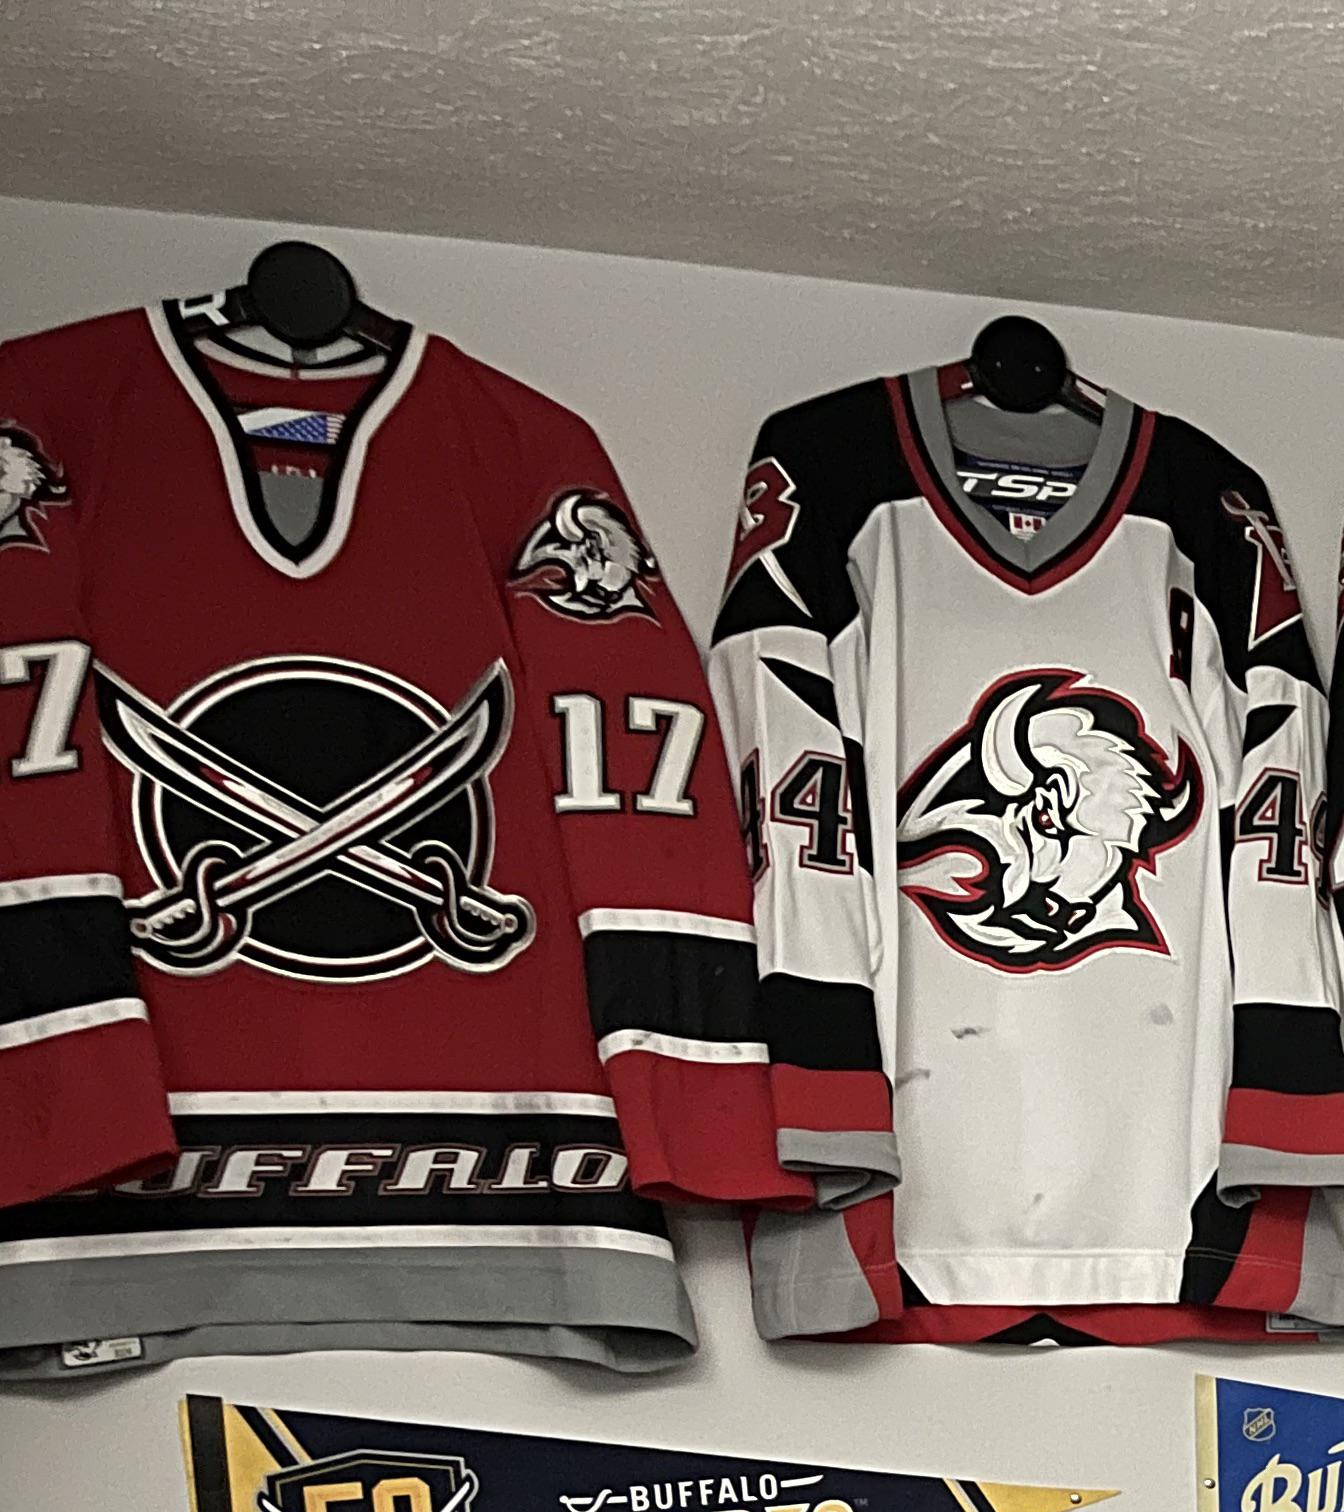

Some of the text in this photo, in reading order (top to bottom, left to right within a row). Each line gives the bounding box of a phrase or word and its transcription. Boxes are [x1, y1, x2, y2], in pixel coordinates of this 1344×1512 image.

[553, 693, 704, 817] 17
[108, 1143, 634, 1198] UFFALO
[629, 1473, 778, 1512] BUFFALO
